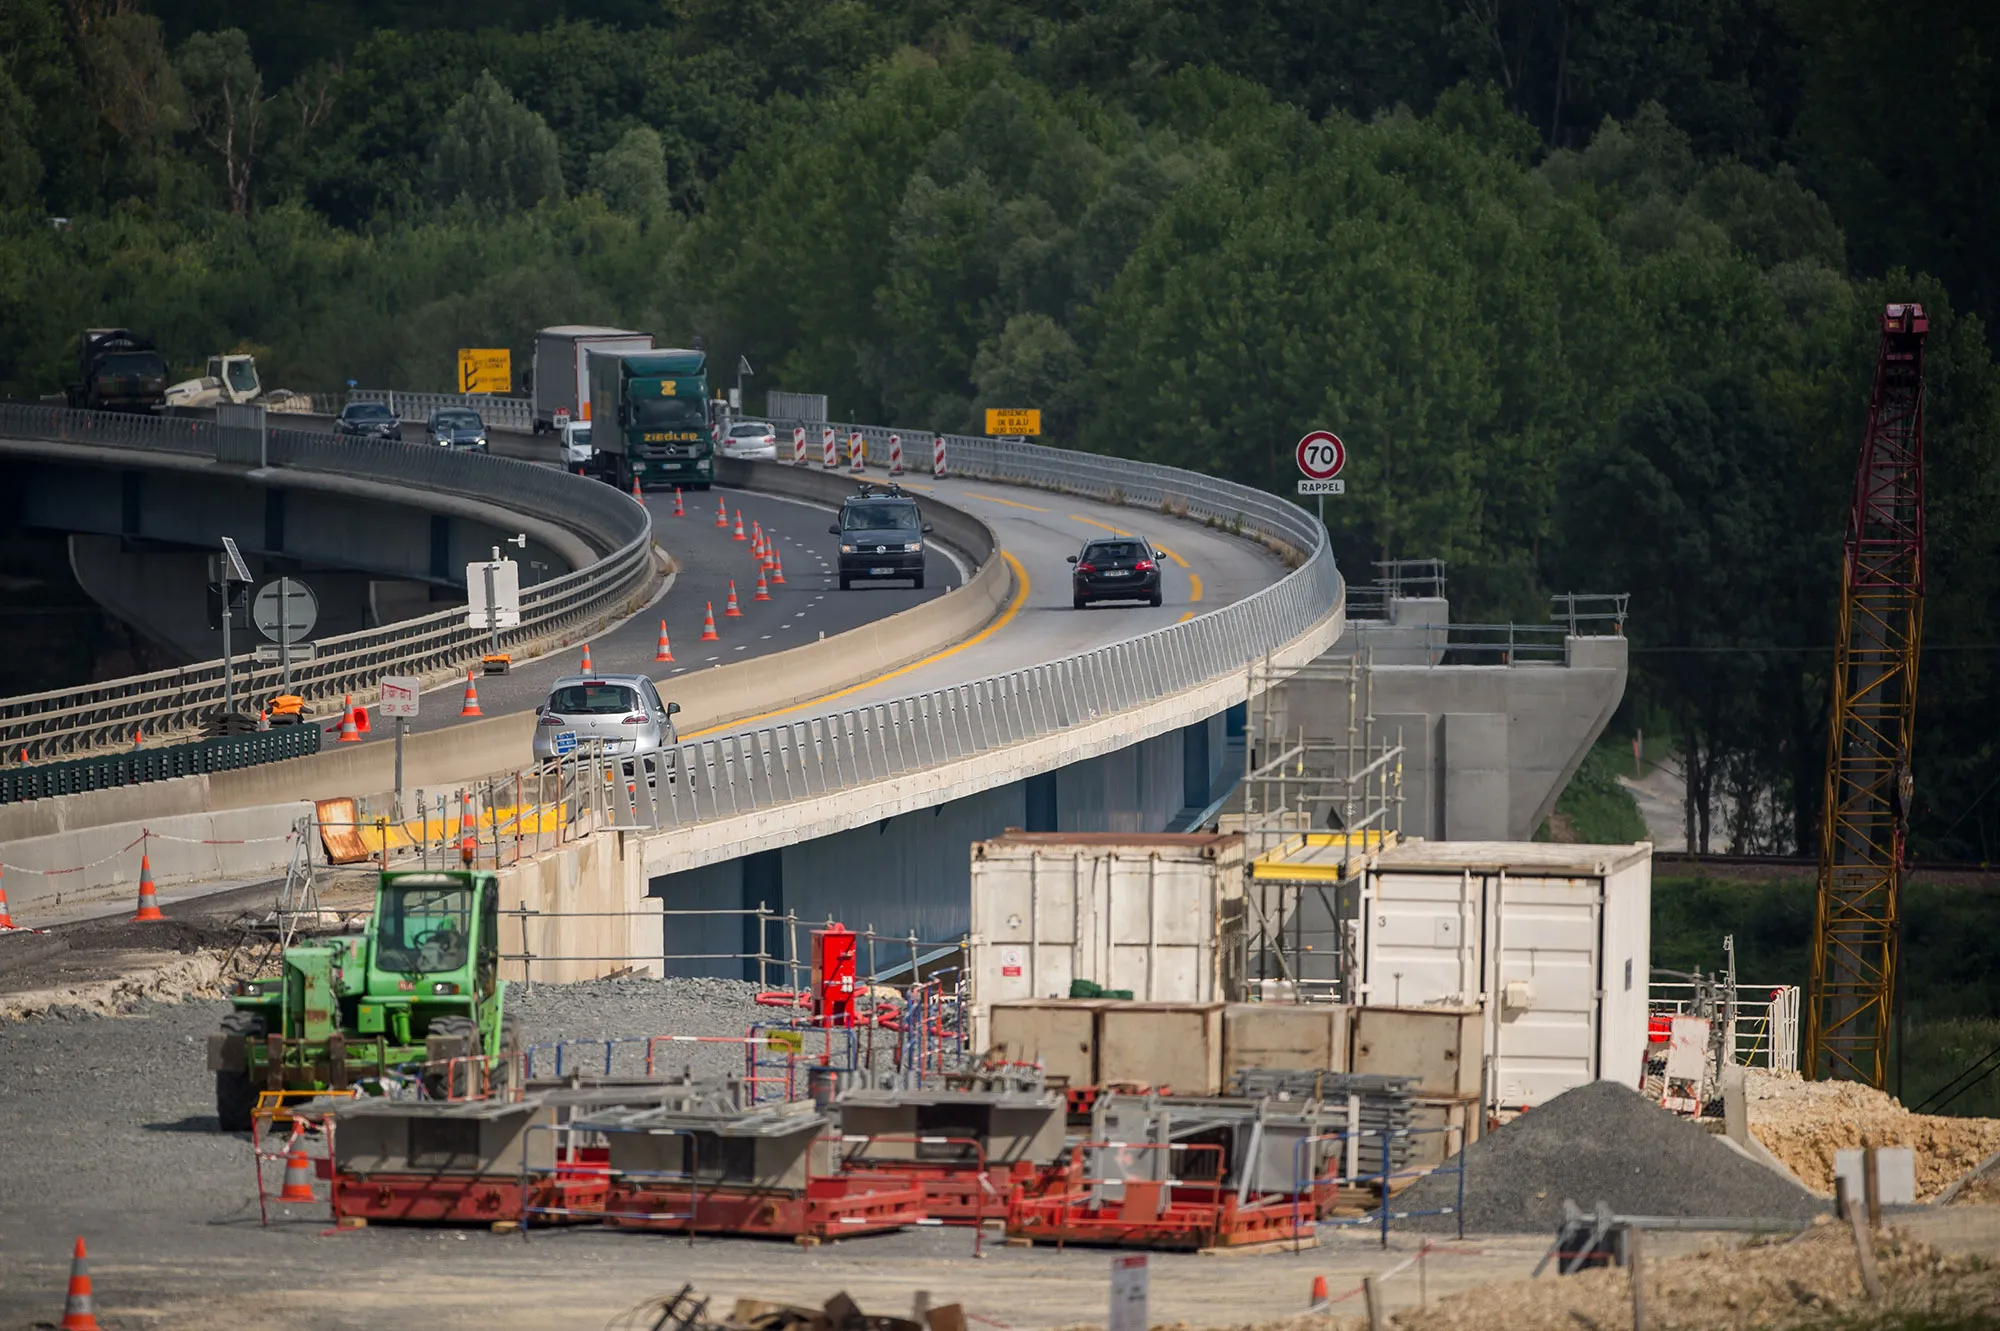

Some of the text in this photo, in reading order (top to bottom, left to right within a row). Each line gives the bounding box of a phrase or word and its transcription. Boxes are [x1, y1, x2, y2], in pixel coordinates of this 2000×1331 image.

[643, 432, 698, 442] ZIEGLER
[1307, 445, 1335, 465] 70
[1301, 483, 1341, 492] RAPPEL
[1378, 915, 1387, 928] 3
